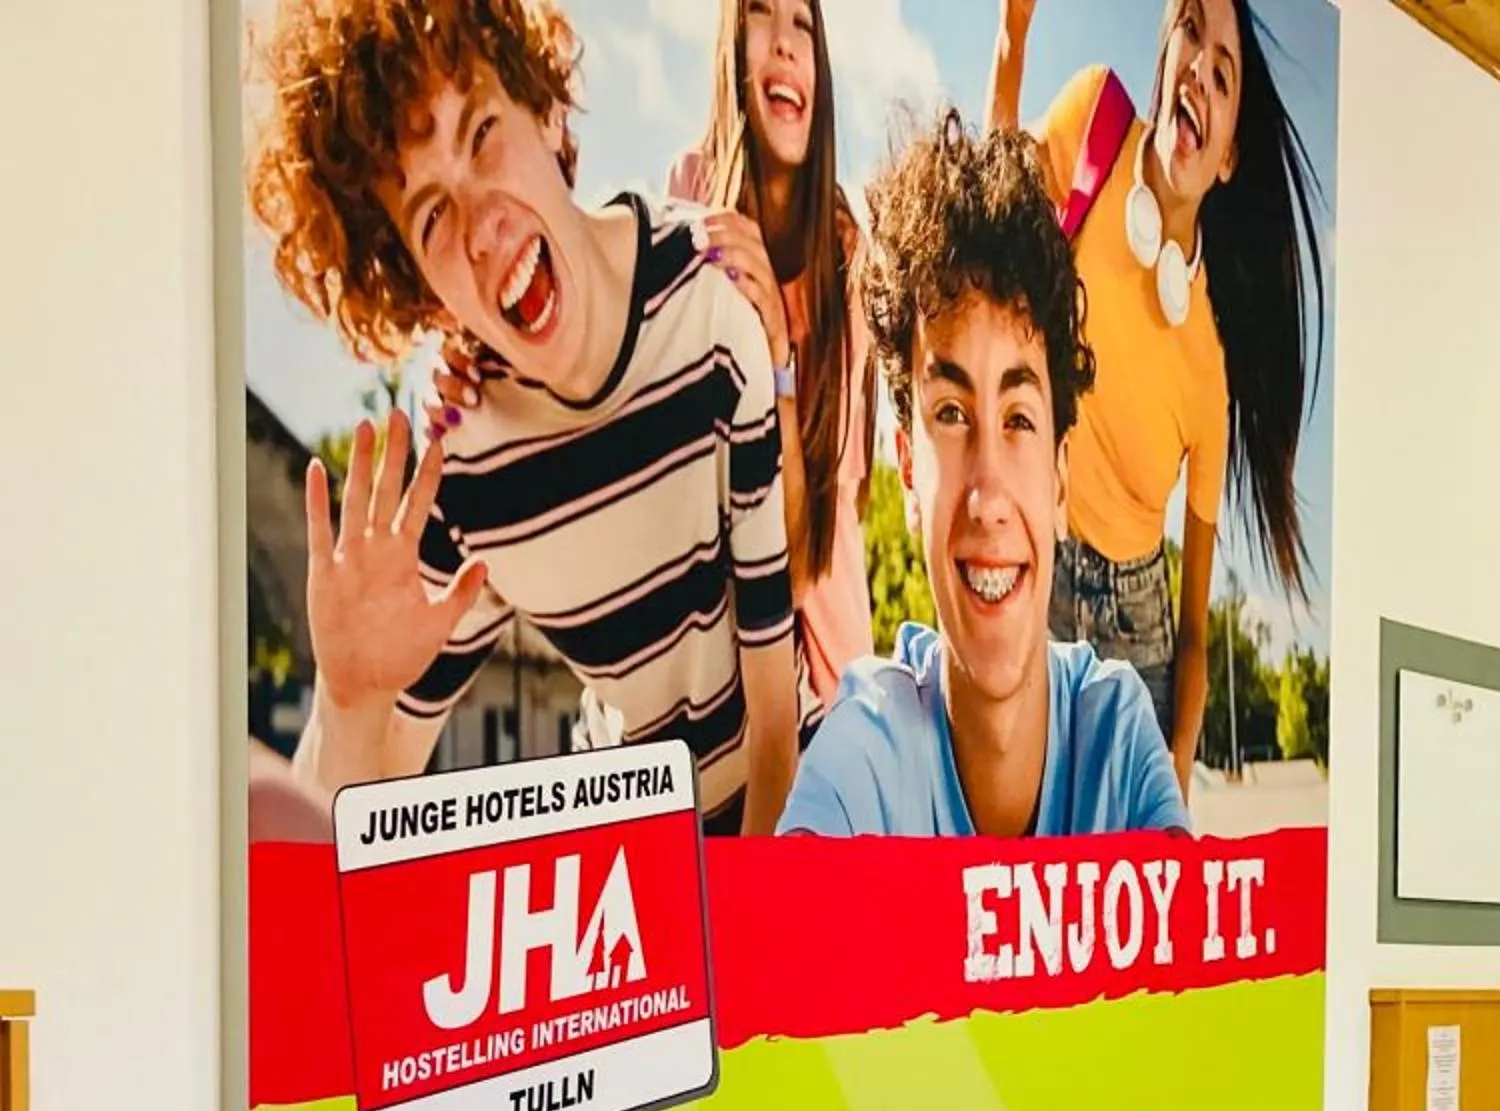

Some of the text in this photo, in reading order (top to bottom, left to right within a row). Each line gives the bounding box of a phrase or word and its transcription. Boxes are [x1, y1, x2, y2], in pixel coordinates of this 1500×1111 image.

[360, 765, 675, 845] JUNGE HOTELS AUSTRIA
[422, 843, 647, 1030] JHA
[961, 858, 1276, 983] ENJOY IT.
[381, 985, 692, 1090] HOSTELLING INTERNATIONAL
